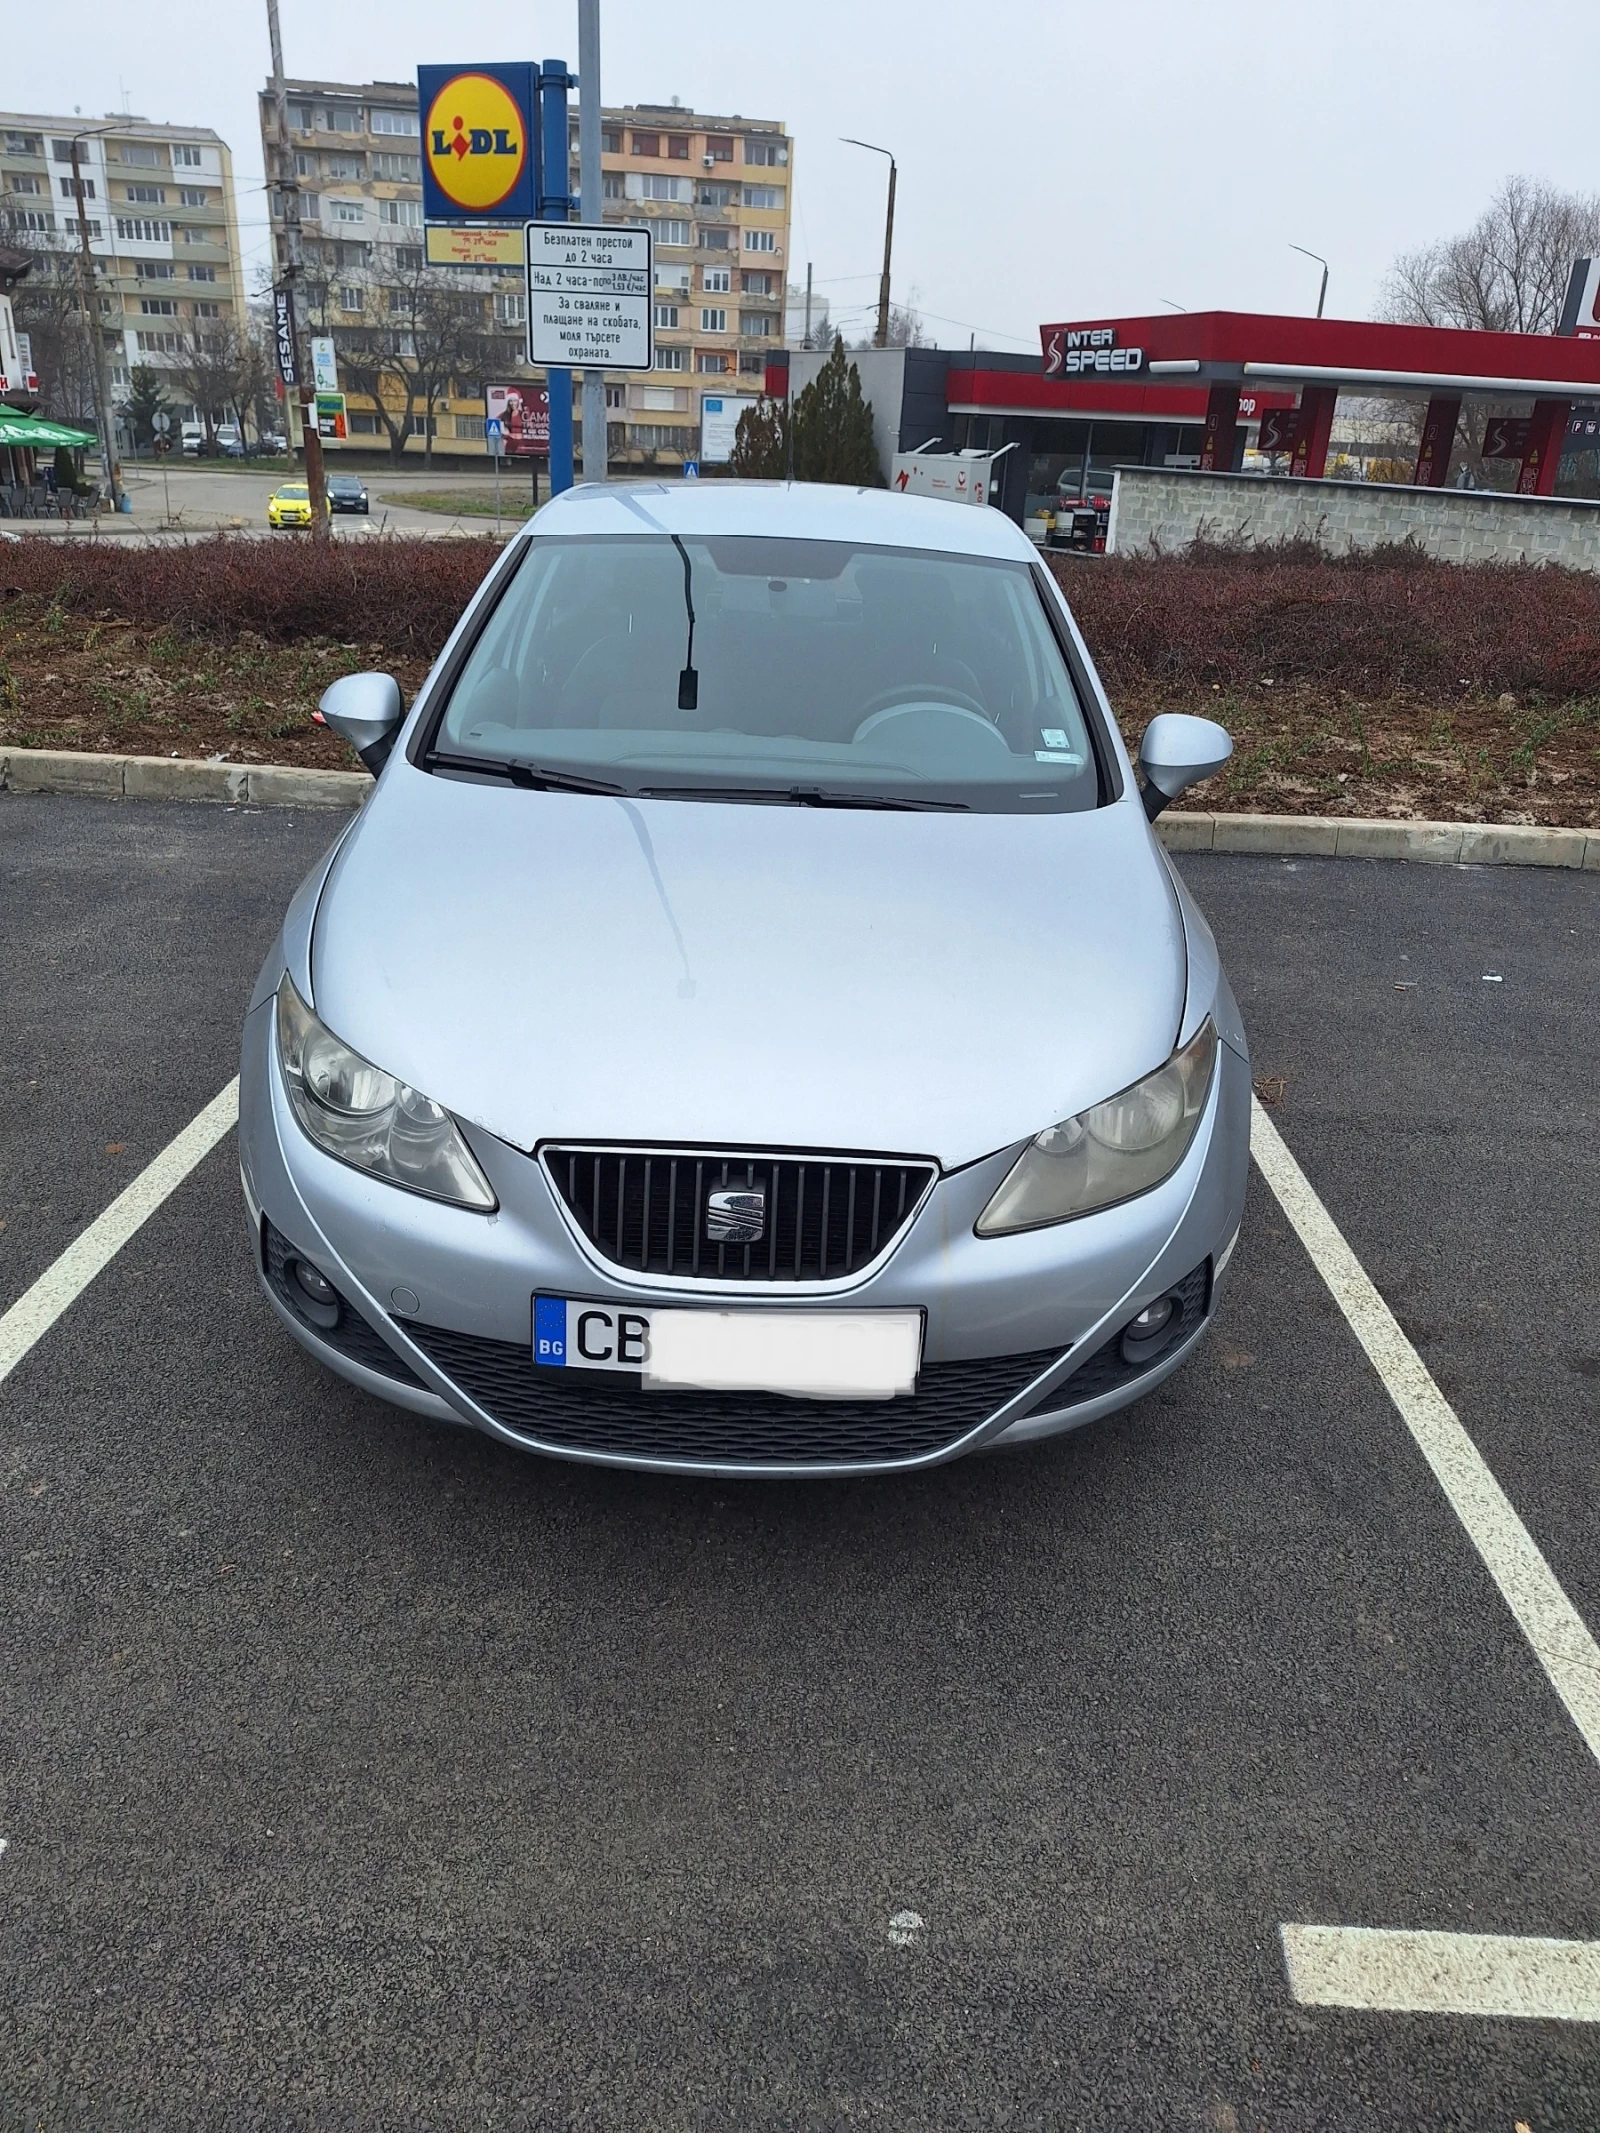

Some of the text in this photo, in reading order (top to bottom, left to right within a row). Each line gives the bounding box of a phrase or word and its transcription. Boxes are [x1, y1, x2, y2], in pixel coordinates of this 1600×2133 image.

[544, 232, 633, 250] Безплатен престой
[565, 250, 613, 264] до 2 часа
[534, 271, 552, 286] Над
[556, 273, 562, 285] 2
[558, 296, 621, 311] За сваляне и
[543, 314, 642, 330] плащане на скобата,
[276, 293, 294, 383] SESAME
[559, 331, 621, 345] моля търсете
[1067, 329, 1113, 348] INTER
[568, 347, 613, 360] охраната.
[1066, 348, 1142, 372] SPEED
[539, 1339, 564, 1356] BG
